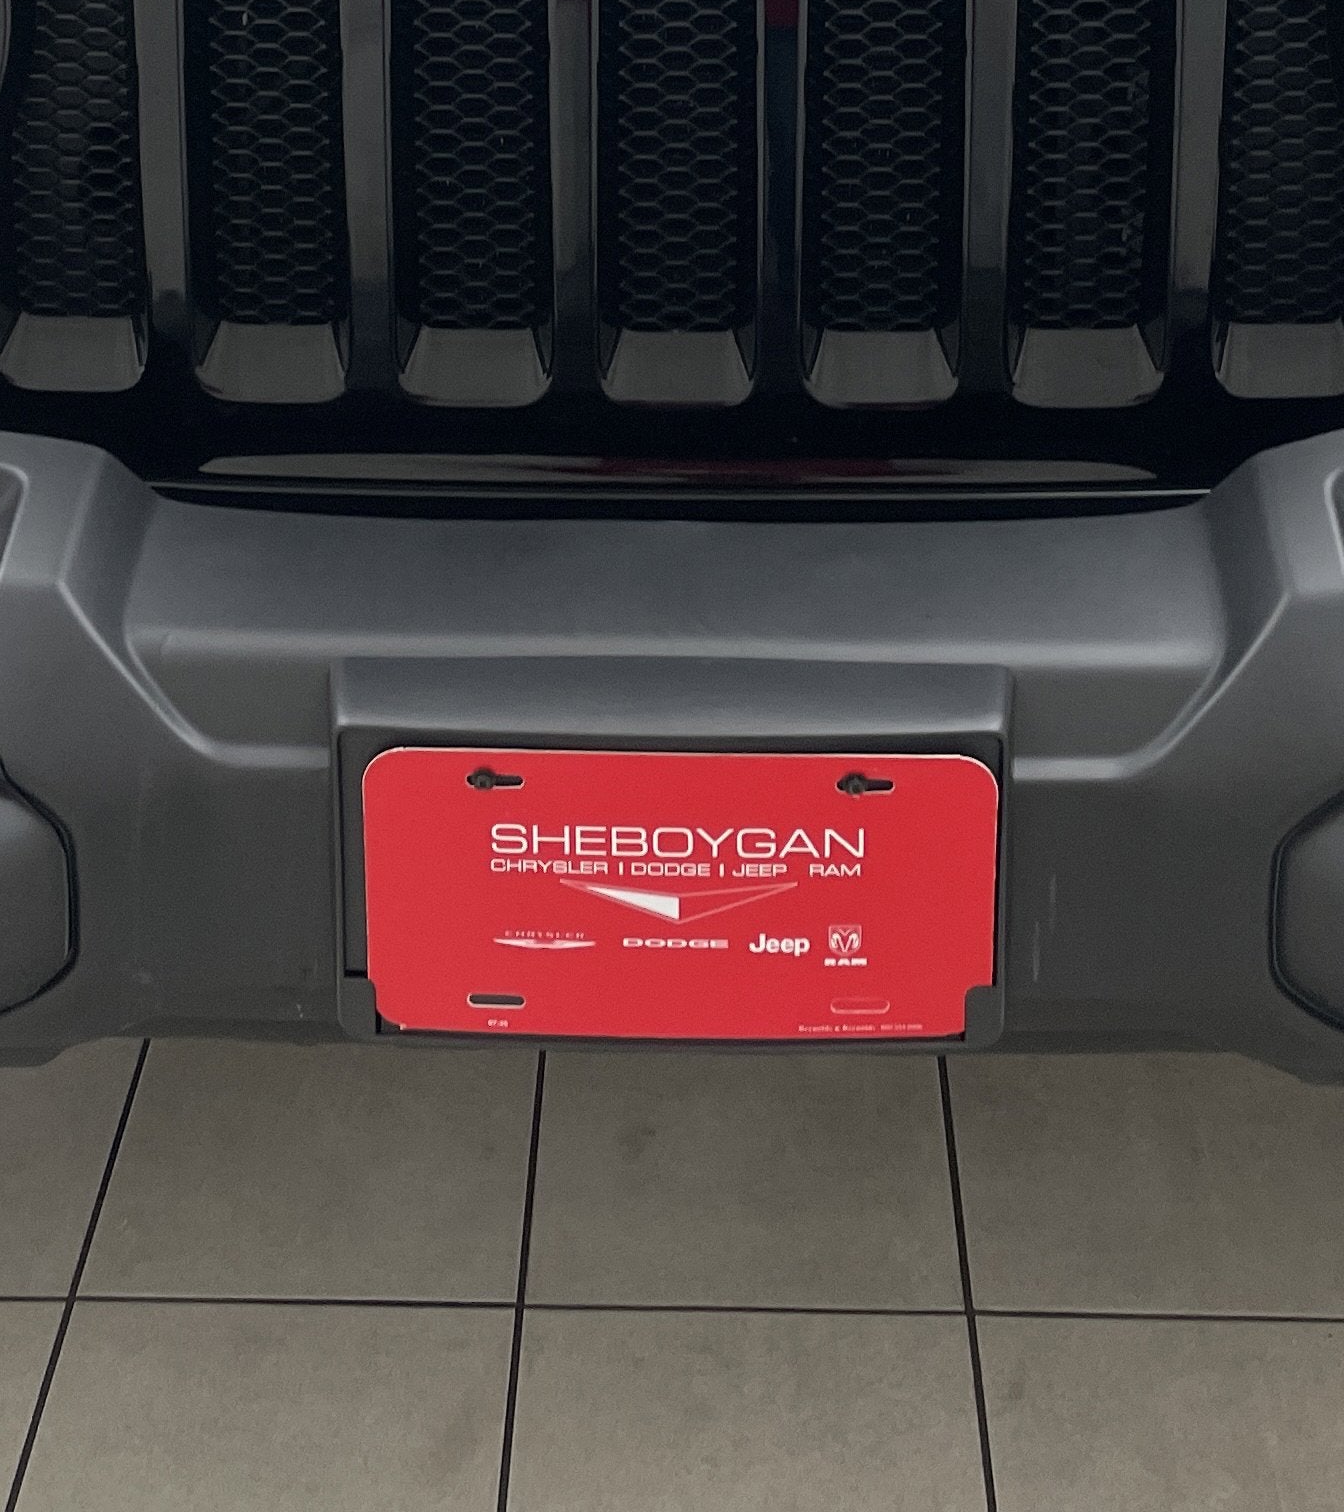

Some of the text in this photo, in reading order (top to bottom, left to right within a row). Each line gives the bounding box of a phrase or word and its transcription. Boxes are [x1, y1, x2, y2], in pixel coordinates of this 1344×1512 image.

[490, 823, 865, 859] SHEBOYGAN
[490, 857, 862, 878] CHRYSLER DODGE JEEP RAM
[622, 937, 730, 949] DODGE
[748, 932, 811, 957] Jeep
[823, 957, 868, 967] RAM
